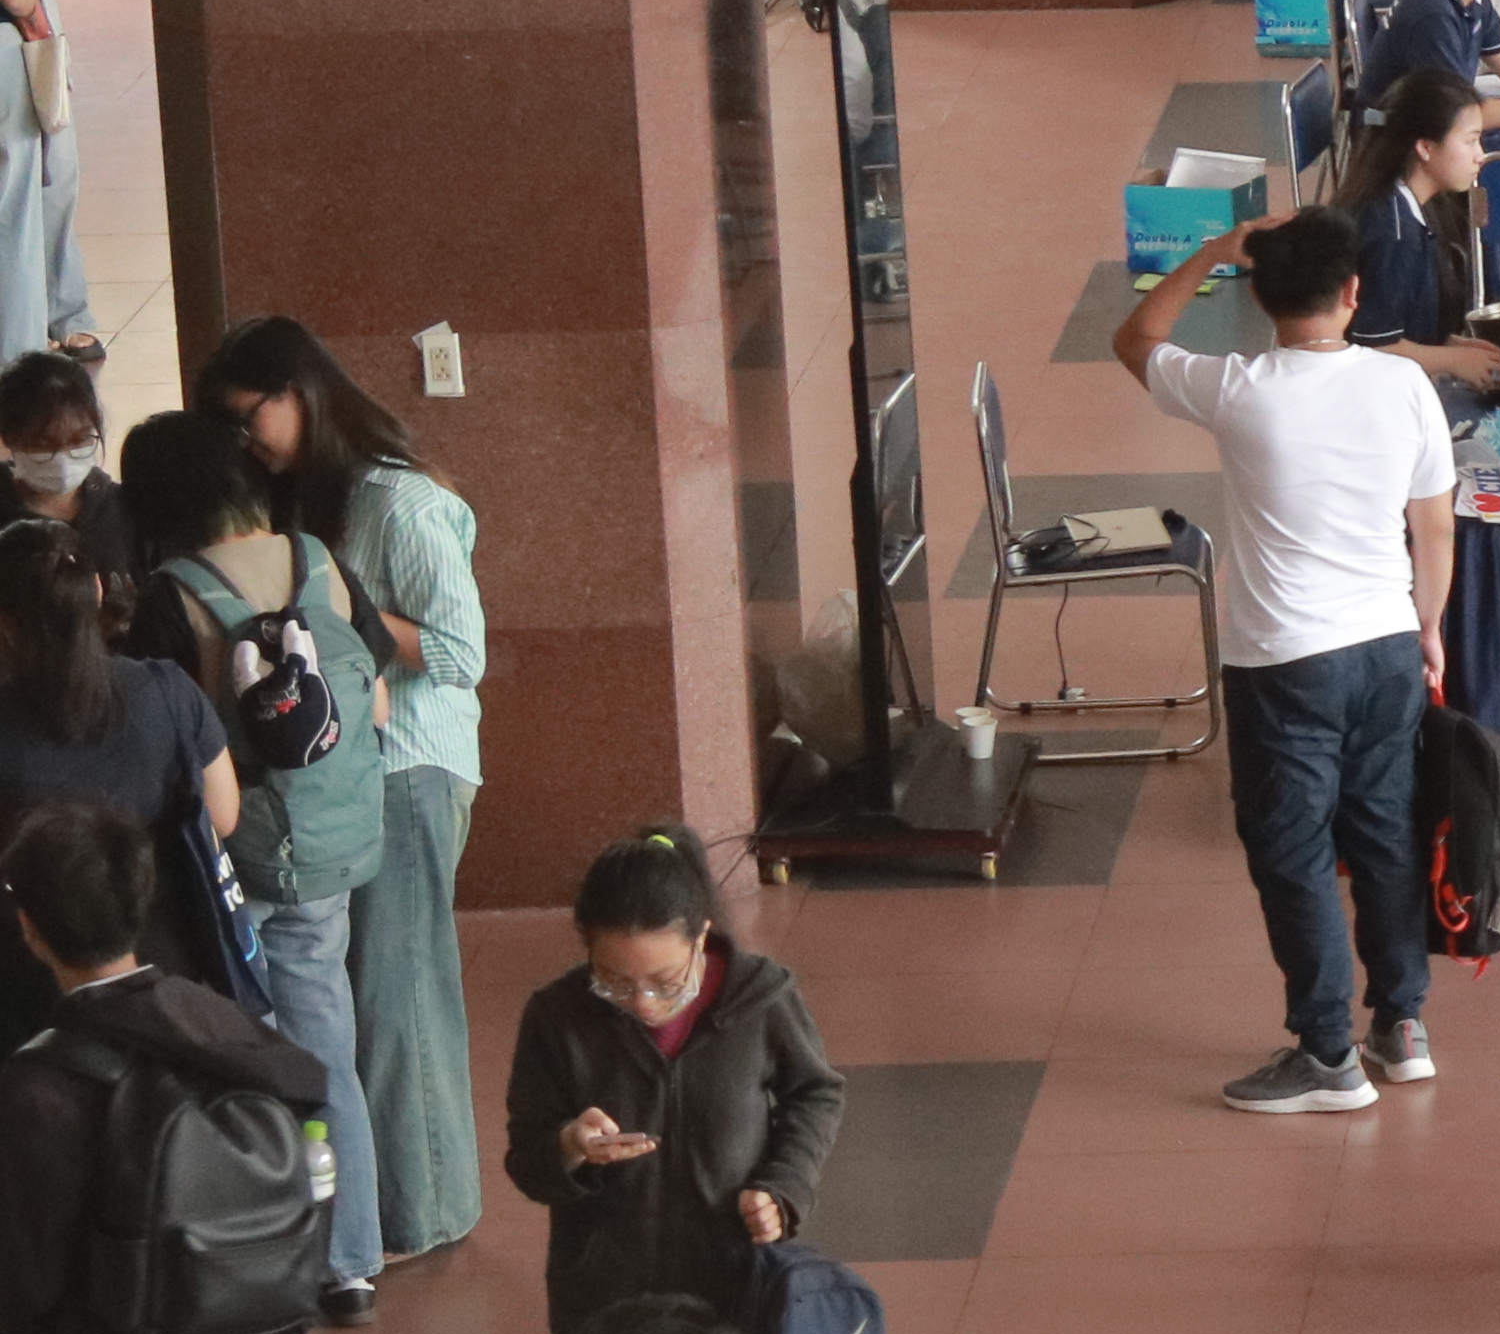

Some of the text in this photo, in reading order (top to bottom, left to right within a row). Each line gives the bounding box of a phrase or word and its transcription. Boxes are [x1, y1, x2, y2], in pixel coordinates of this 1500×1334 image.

[1267, 18, 1319, 28] Double A
[1135, 232, 1192, 243] Double A
